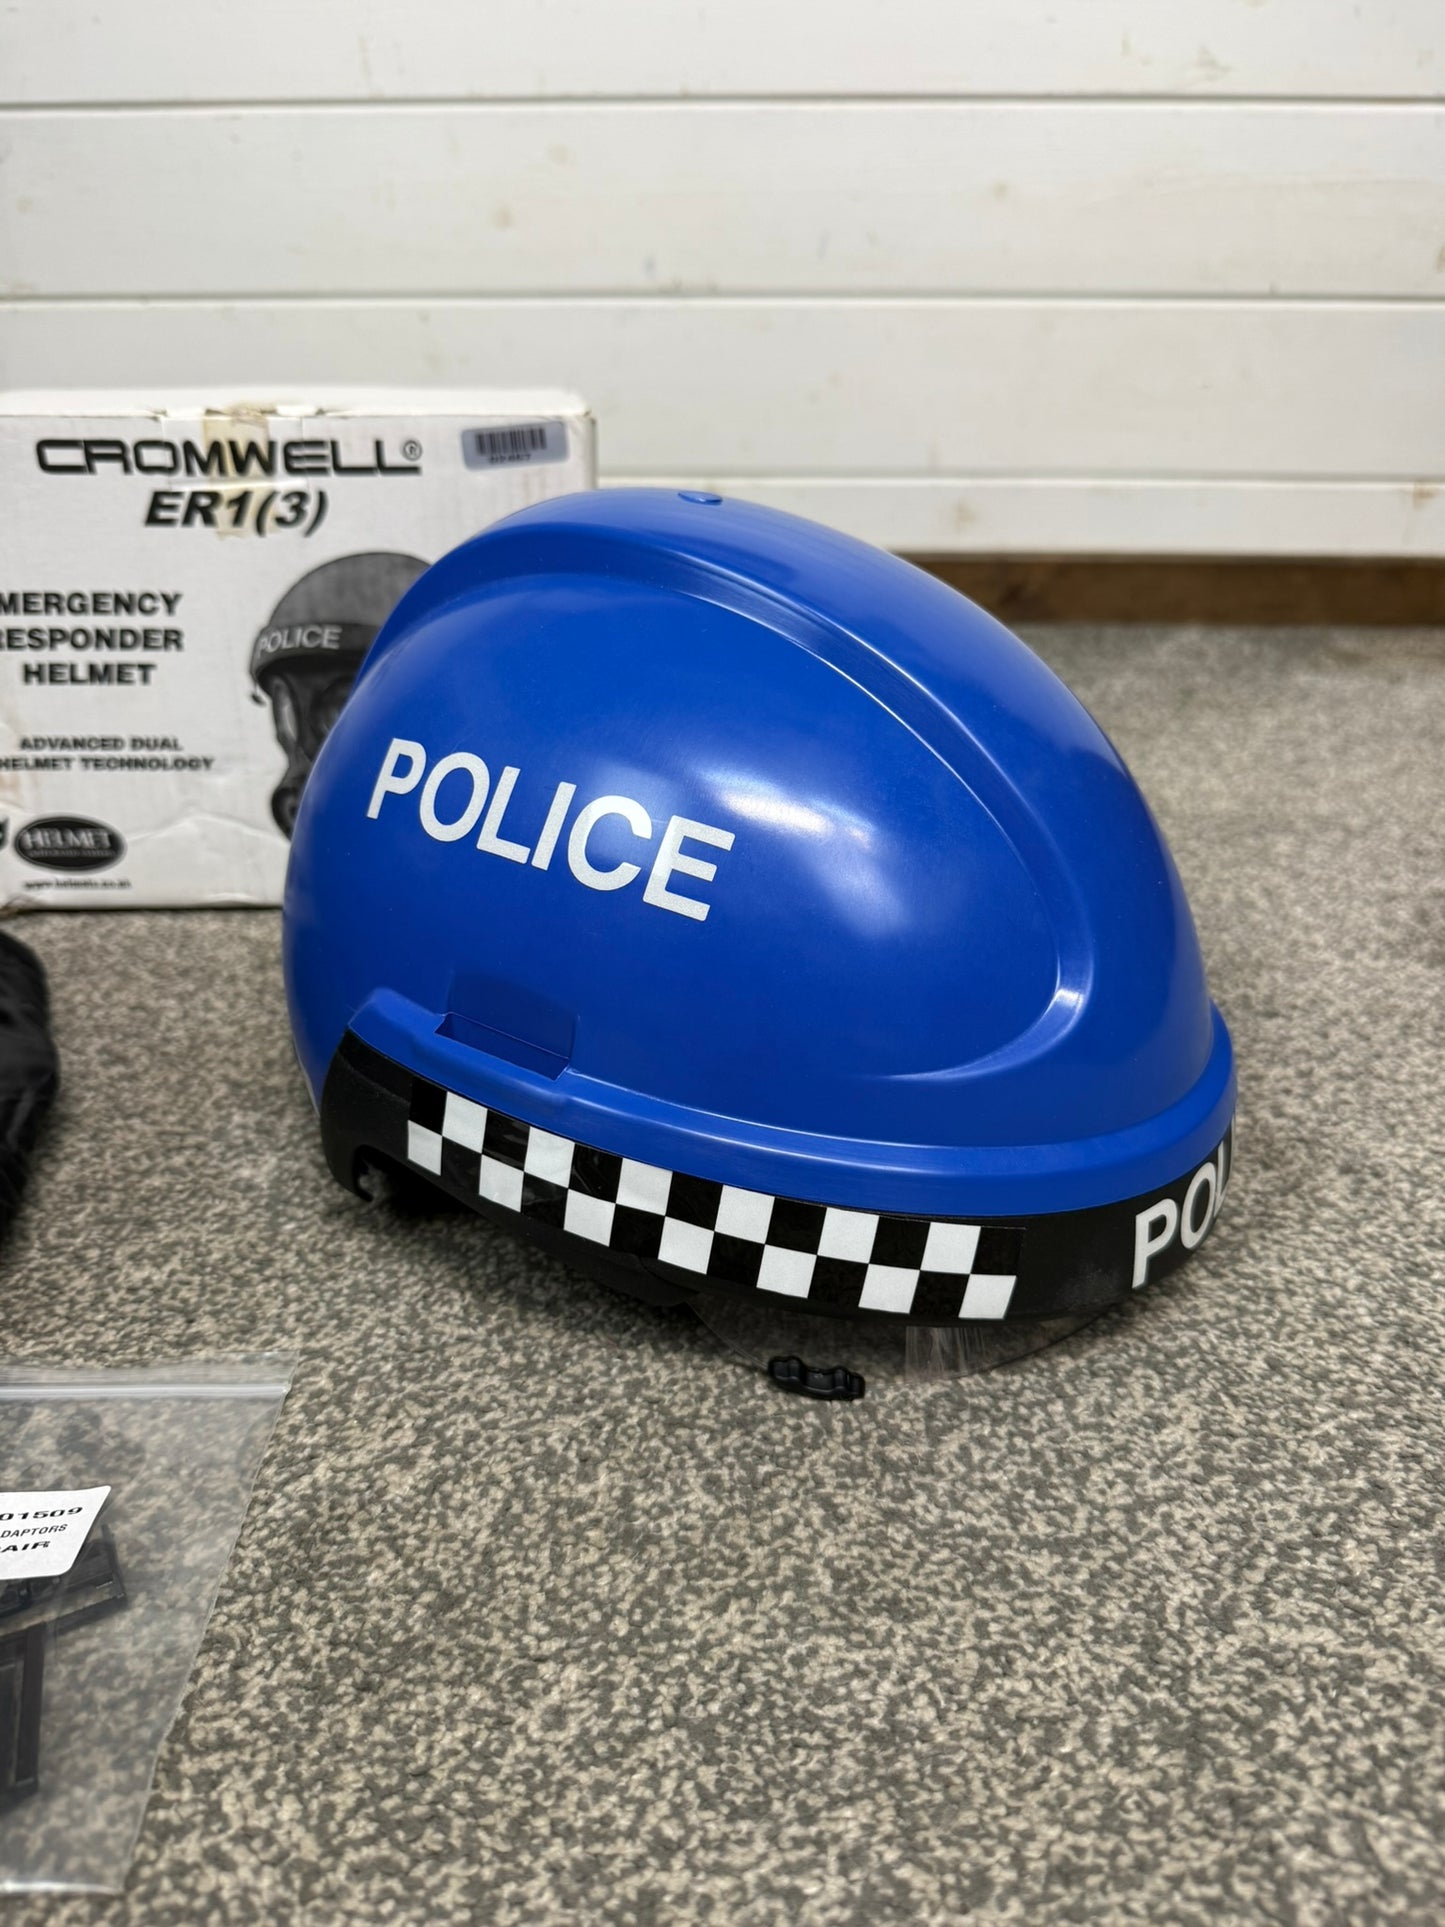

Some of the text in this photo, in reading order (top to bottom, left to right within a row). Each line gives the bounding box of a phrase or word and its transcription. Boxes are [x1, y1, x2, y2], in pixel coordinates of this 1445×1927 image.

[144, 490, 328, 537] ER1(3)
[0, 627, 184, 651] ESPONDER
[256, 624, 343, 659] POLICE
[22, 662, 156, 685] HELMET
[20, 736, 183, 751] ADVANCED DUAL
[80, 756, 214, 771] TECHNOLOGY
[366, 737, 736, 922] POLICE
[1132, 1113, 1236, 1289] POL
[0, 1540, 51, 1554] AIR
